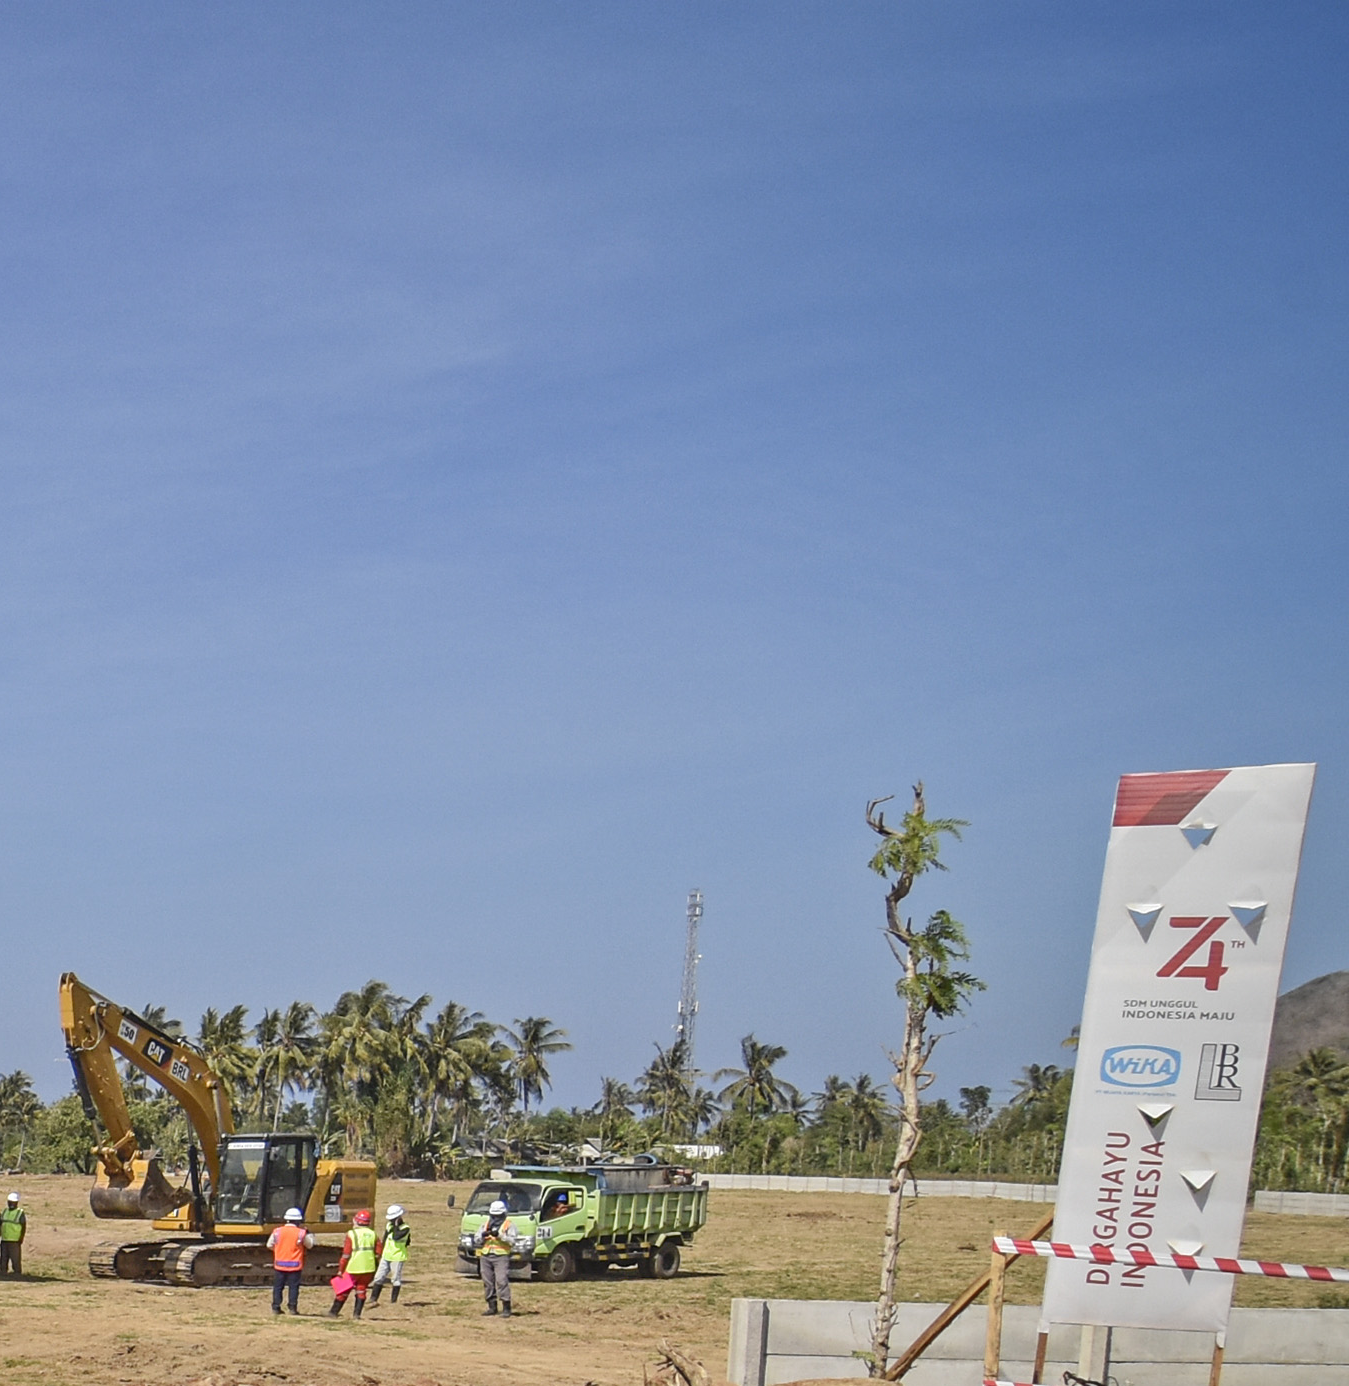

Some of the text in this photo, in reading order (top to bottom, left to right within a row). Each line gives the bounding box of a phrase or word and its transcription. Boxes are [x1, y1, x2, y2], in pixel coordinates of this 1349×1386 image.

[1123, 999, 1198, 1009] SDM UNGGUL
[1122, 1010, 1235, 1021] INDONESIA MAJU
[124, 1026, 135, 1041] 50
[148, 1041, 166, 1064] CAT
[172, 1062, 187, 1082] BRL
